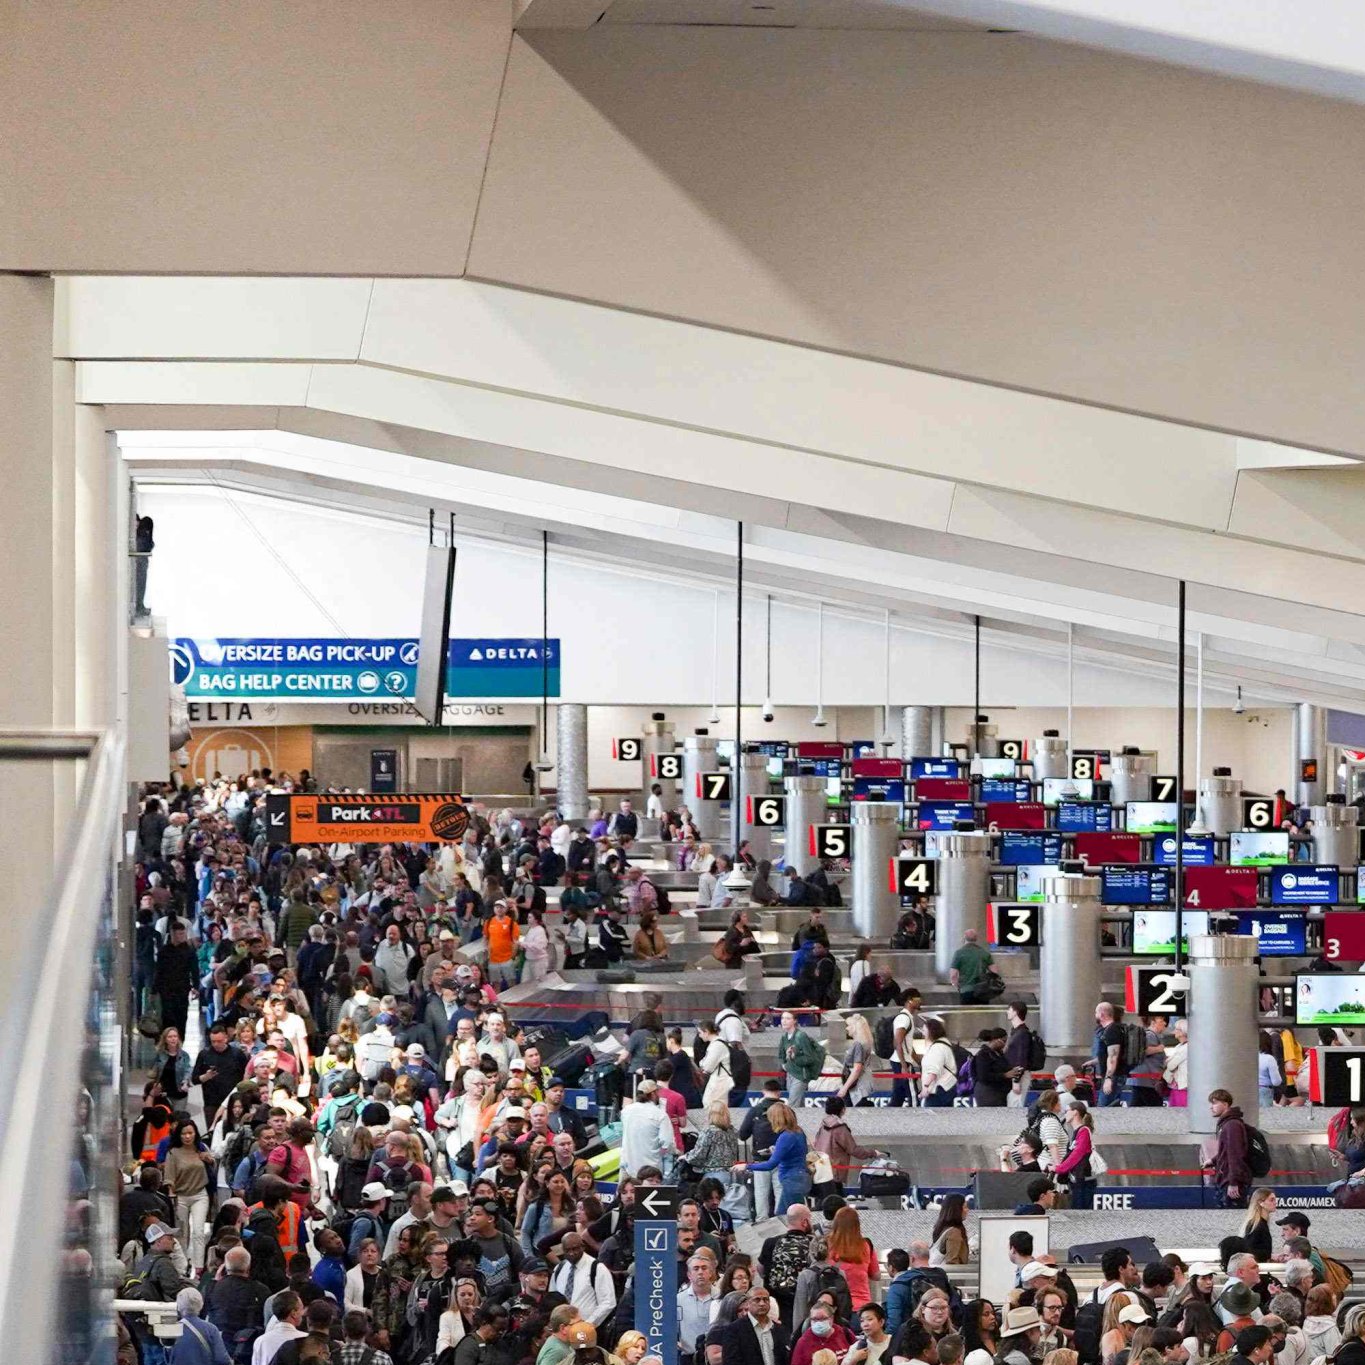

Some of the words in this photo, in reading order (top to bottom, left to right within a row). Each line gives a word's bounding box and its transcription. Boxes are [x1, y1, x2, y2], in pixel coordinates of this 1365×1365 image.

[287, 646, 323, 662] BAG
[327, 646, 396, 662] PICK-UP
[486, 649, 538, 660] DELTA
[200, 674, 235, 690] BAG
[240, 674, 282, 690] HELP
[286, 674, 352, 690] CENTER
[622, 740, 639, 759] 9
[1003, 742, 1019, 758] 9
[661, 756, 679, 777] 8
[1074, 760, 1091, 779] 8
[708, 776, 726, 799] 7
[1157, 779, 1174, 800] 7
[332, 807, 405, 821] ParkATL
[434, 811, 467, 830] DETOUR
[759, 799, 777, 824] 6
[1250, 802, 1270, 827] 6
[318, 827, 381, 839] On-Airport
[384, 827, 426, 839] Parking
[824, 829, 845, 856] 5
[904, 863, 931, 893] 4
[1187, 890, 1200, 905] 4
[1006, 909, 1031, 942] 3
[1327, 939, 1340, 958] 3
[1148, 974, 1181, 1013] 2
[1346, 1058, 1361, 1102] 1
